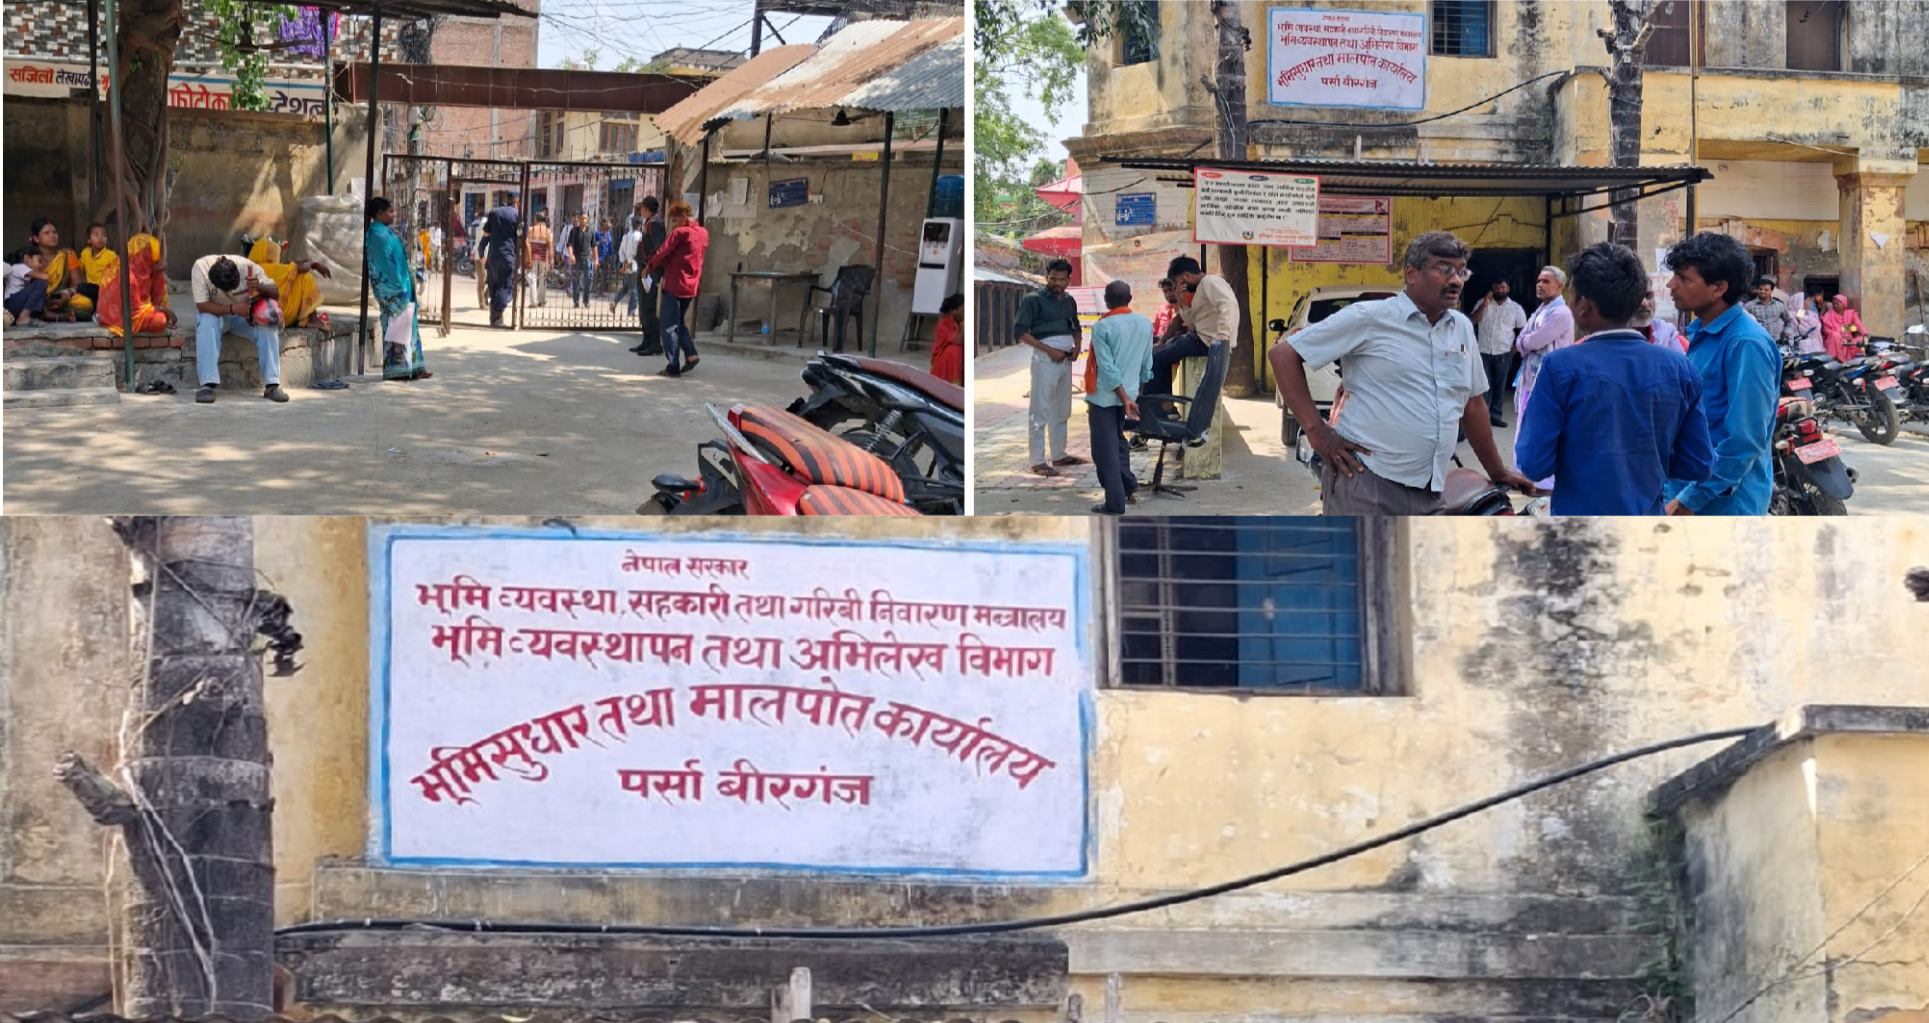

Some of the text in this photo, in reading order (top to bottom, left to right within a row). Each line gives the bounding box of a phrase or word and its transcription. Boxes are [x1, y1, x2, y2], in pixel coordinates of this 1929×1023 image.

[1316, 54, 1334, 69] तथा
[1340, 38, 1358, 50] तथा
[622, 549, 748, 579] नेपाल सरकार
[414, 574, 492, 615] भूमि
[628, 582, 731, 623] सहकारी
[734, 593, 785, 624] तथा
[789, 587, 863, 626] गरिबी
[870, 589, 970, 630] निवारण
[431, 615, 1055, 681] भूमि व्यवस्थापन तथा अभिलेख विभाग
[595, 687, 675, 743] तथा
[689, 676, 875, 738] मालपोत
[874, 700, 1055, 790] कार्यालय
[617, 759, 874, 811] पर्सा बीरगंज
